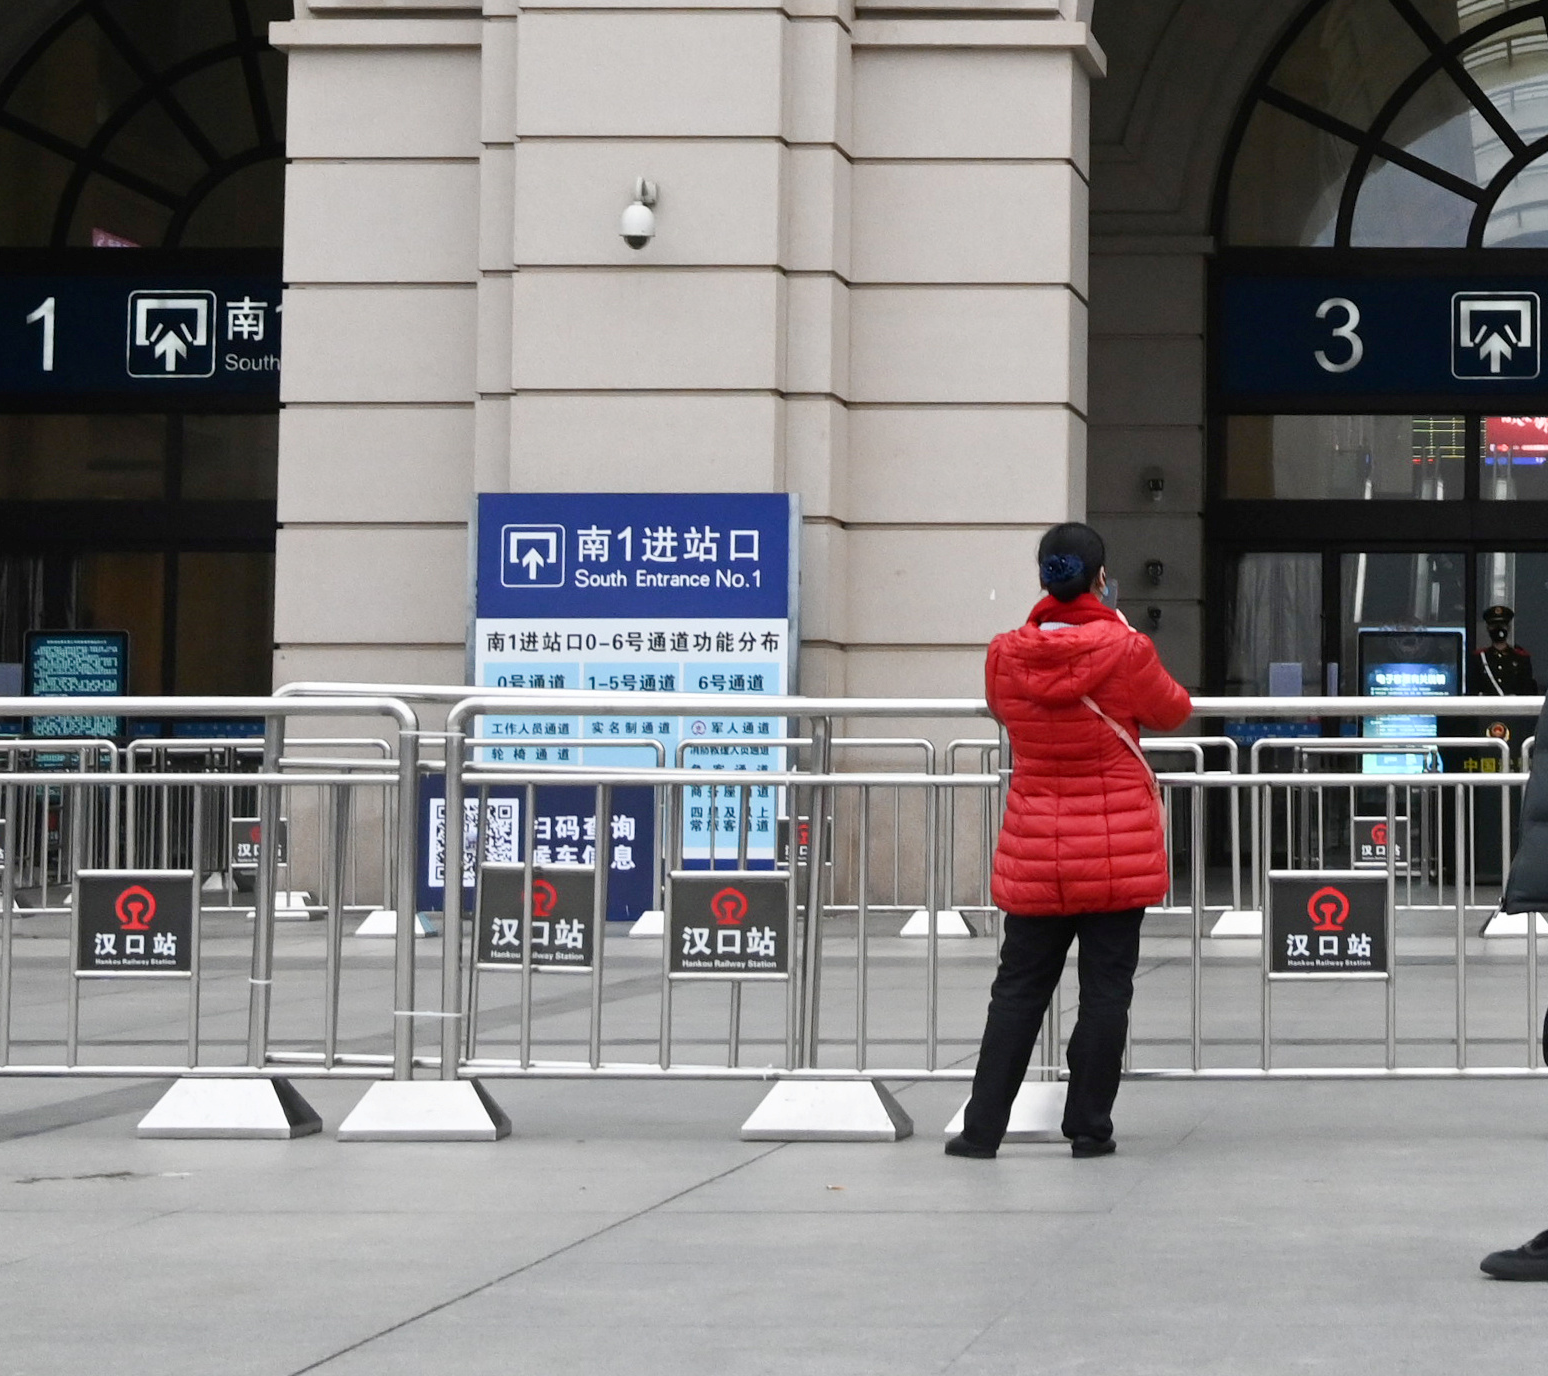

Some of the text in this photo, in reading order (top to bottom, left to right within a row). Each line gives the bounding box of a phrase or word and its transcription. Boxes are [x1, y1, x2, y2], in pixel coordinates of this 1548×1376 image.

[225, 296, 282, 341] 南
[26, 296, 55, 372] 1
[1314, 297, 1364, 373] 3
[577, 525, 760, 562] 南1进站口
[575, 569, 628, 588] South
[636, 569, 711, 588] Entrance
[698, 674, 765, 691] 6号通道
[491, 722, 570, 735] 工作人员通道
[591, 721, 670, 735] 实名制通道
[711, 721, 771, 735] 军人通道
[94, 932, 178, 956] 汉口站
[682, 926, 777, 956] 汉口站
[1286, 933, 1372, 957] 汉口站
